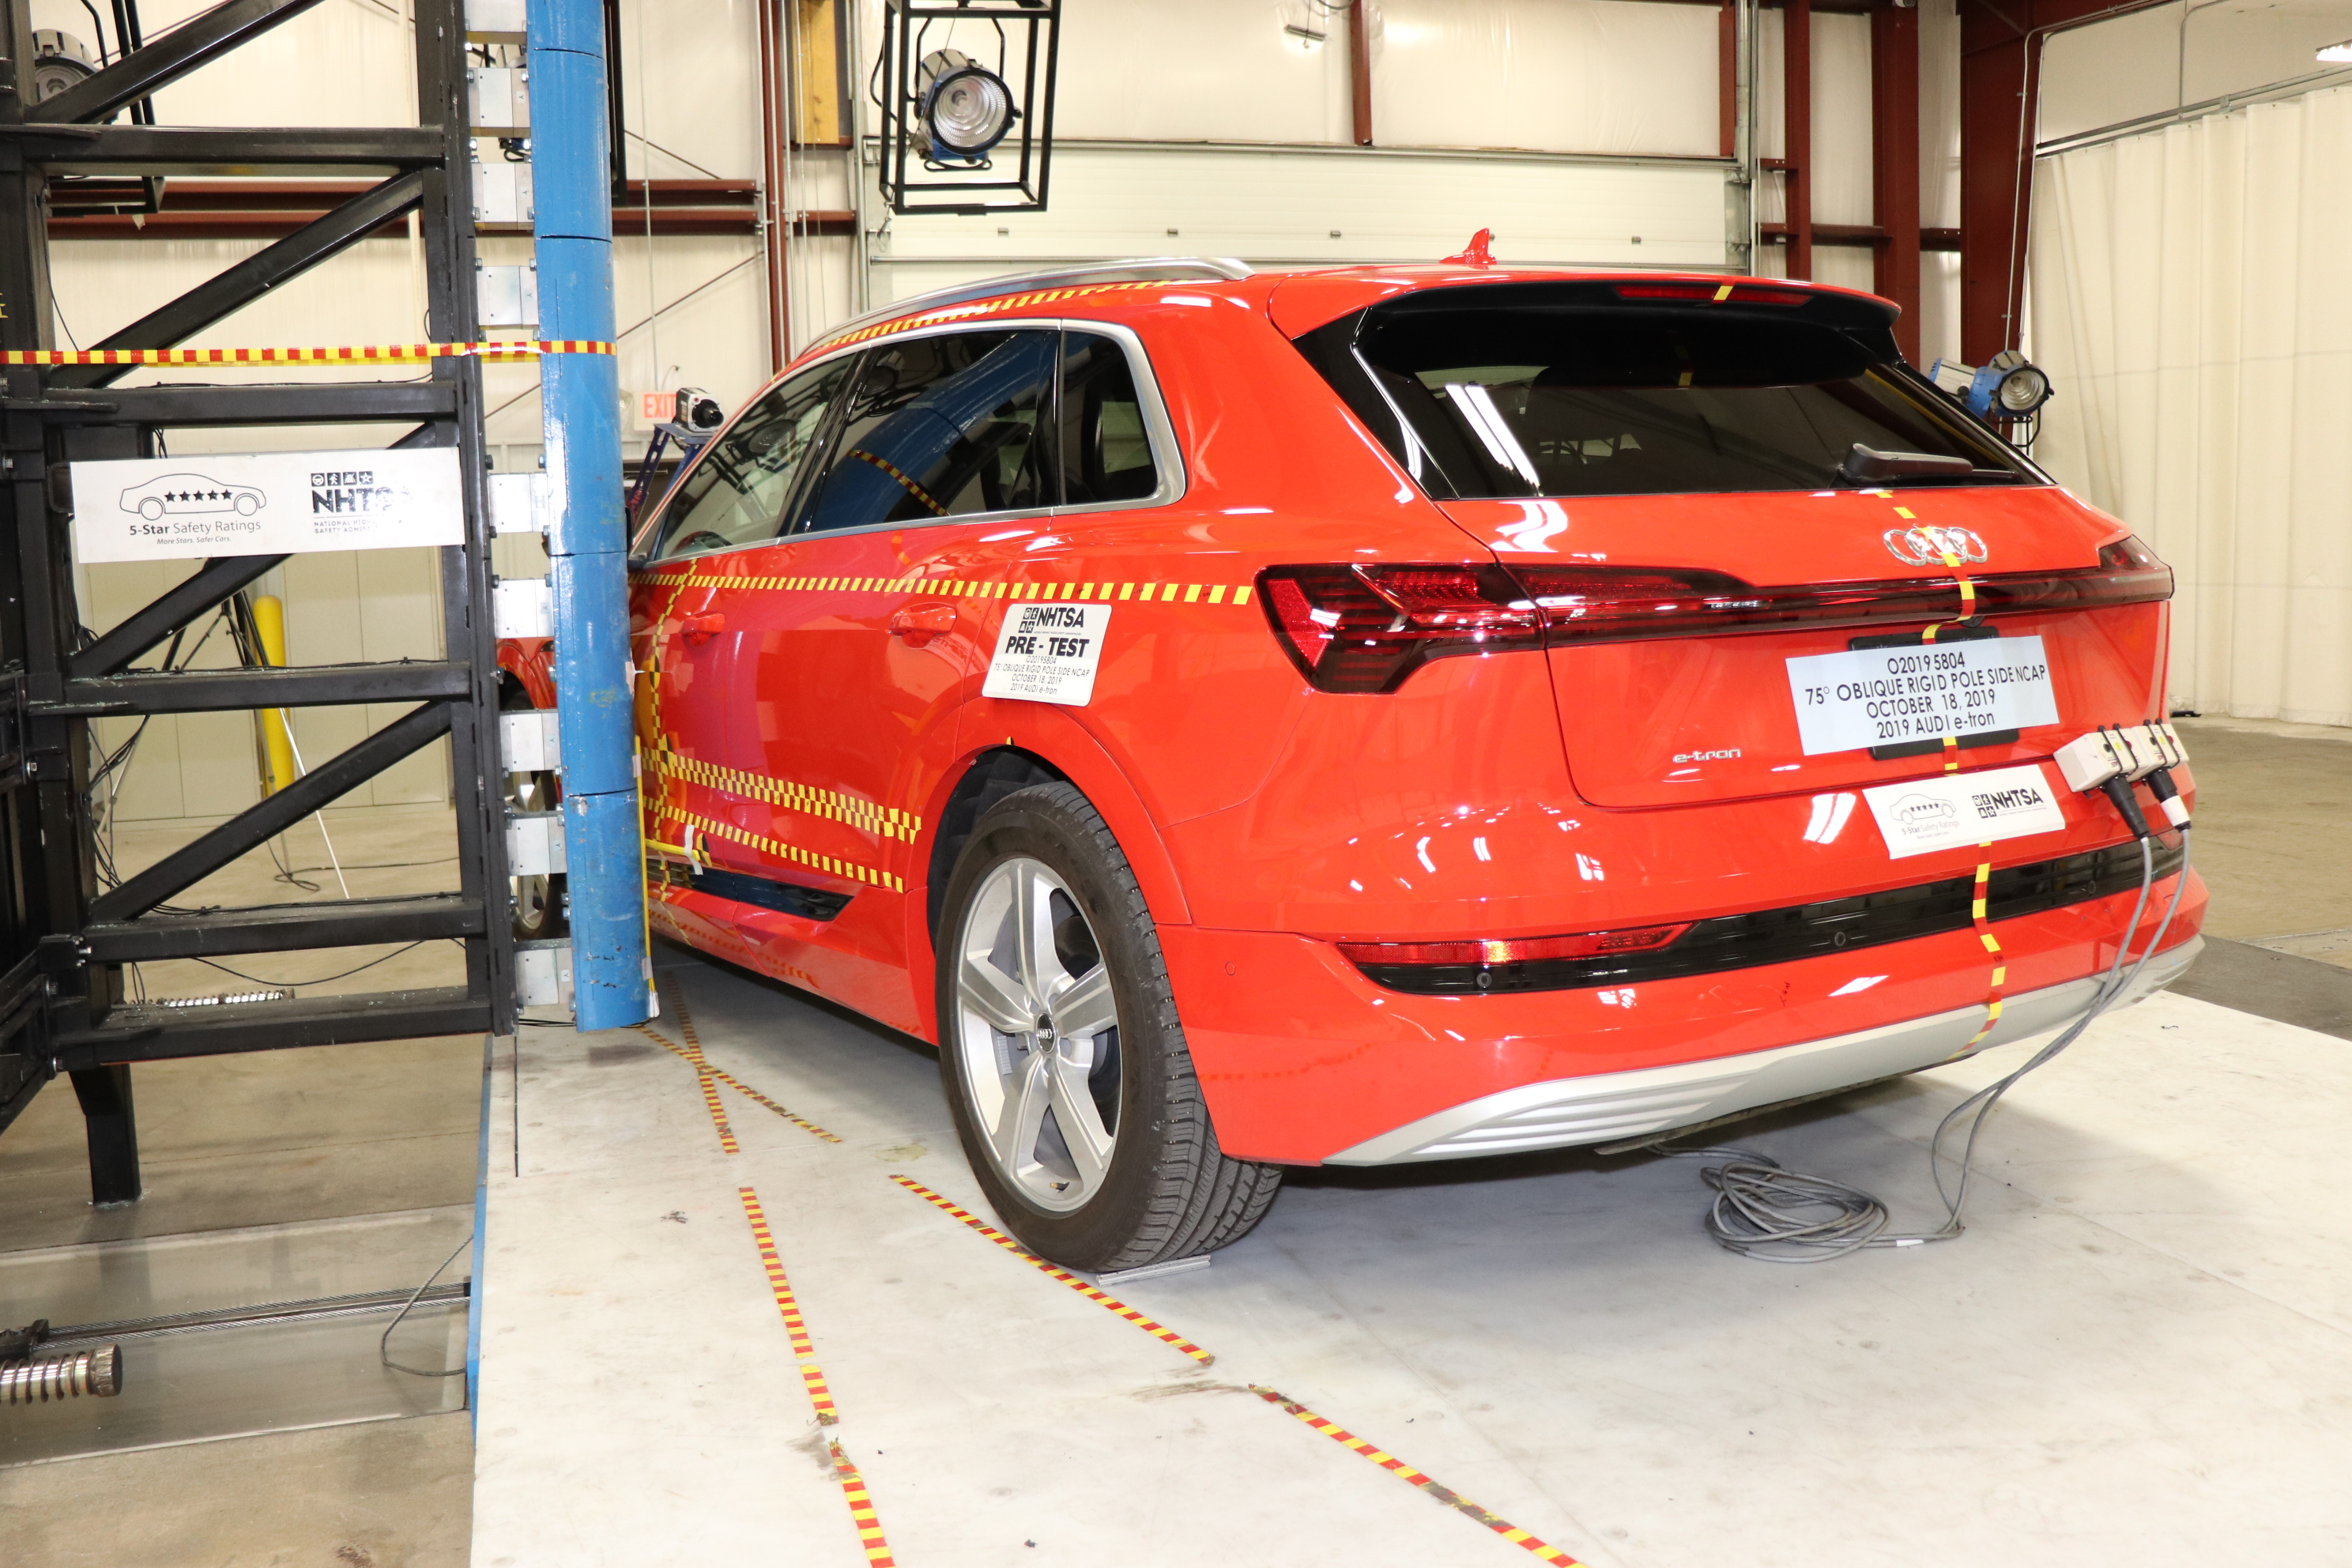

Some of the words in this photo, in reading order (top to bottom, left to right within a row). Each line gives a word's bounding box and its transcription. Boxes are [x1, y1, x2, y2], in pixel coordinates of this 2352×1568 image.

[643, 394, 678, 419] EXIT
[311, 487, 413, 514] NHT
[130, 524, 170, 536] 5-Star
[173, 522, 212, 535] Safety
[215, 520, 262, 533] Ratings
[1036, 607, 1084, 628] NHTSA
[1005, 635, 1038, 654] PRE
[1049, 637, 1090, 658] TEST
[1003, 664, 1025, 673] OBLIQUE
[1026, 665, 1042, 673] RIGID
[1057, 667, 1071, 676] SIDE
[1071, 668, 1090, 677] NCAP
[1012, 673, 1037, 683] OCTOBER
[1038, 675, 1046, 684] 18,
[1047, 676, 1061, 685] 2019
[1010, 683, 1023, 692] 2019
[1039, 685, 1057, 695] e-tron
[1805, 686, 1830, 706] 75°
[1836, 678, 1904, 702] OBLIQUE
[1908, 675, 1947, 694] RIGID
[1951, 670, 1985, 689] POLE
[1988, 667, 2015, 685] SIDE
[2016, 665, 2045, 682] NCAP
[1866, 696, 1934, 718] OCTOBER
[1941, 693, 1962, 711] 18,
[1966, 688, 1996, 707] 2019
[1877, 718, 1909, 739] 2019
[1915, 714, 1951, 734] AUDI
[1954, 711, 1995, 729] e-tron
[1672, 748, 1742, 763] e-tron
[1990, 787, 2044, 810] NHTSA
[1902, 827, 1920, 835] 5-Star
